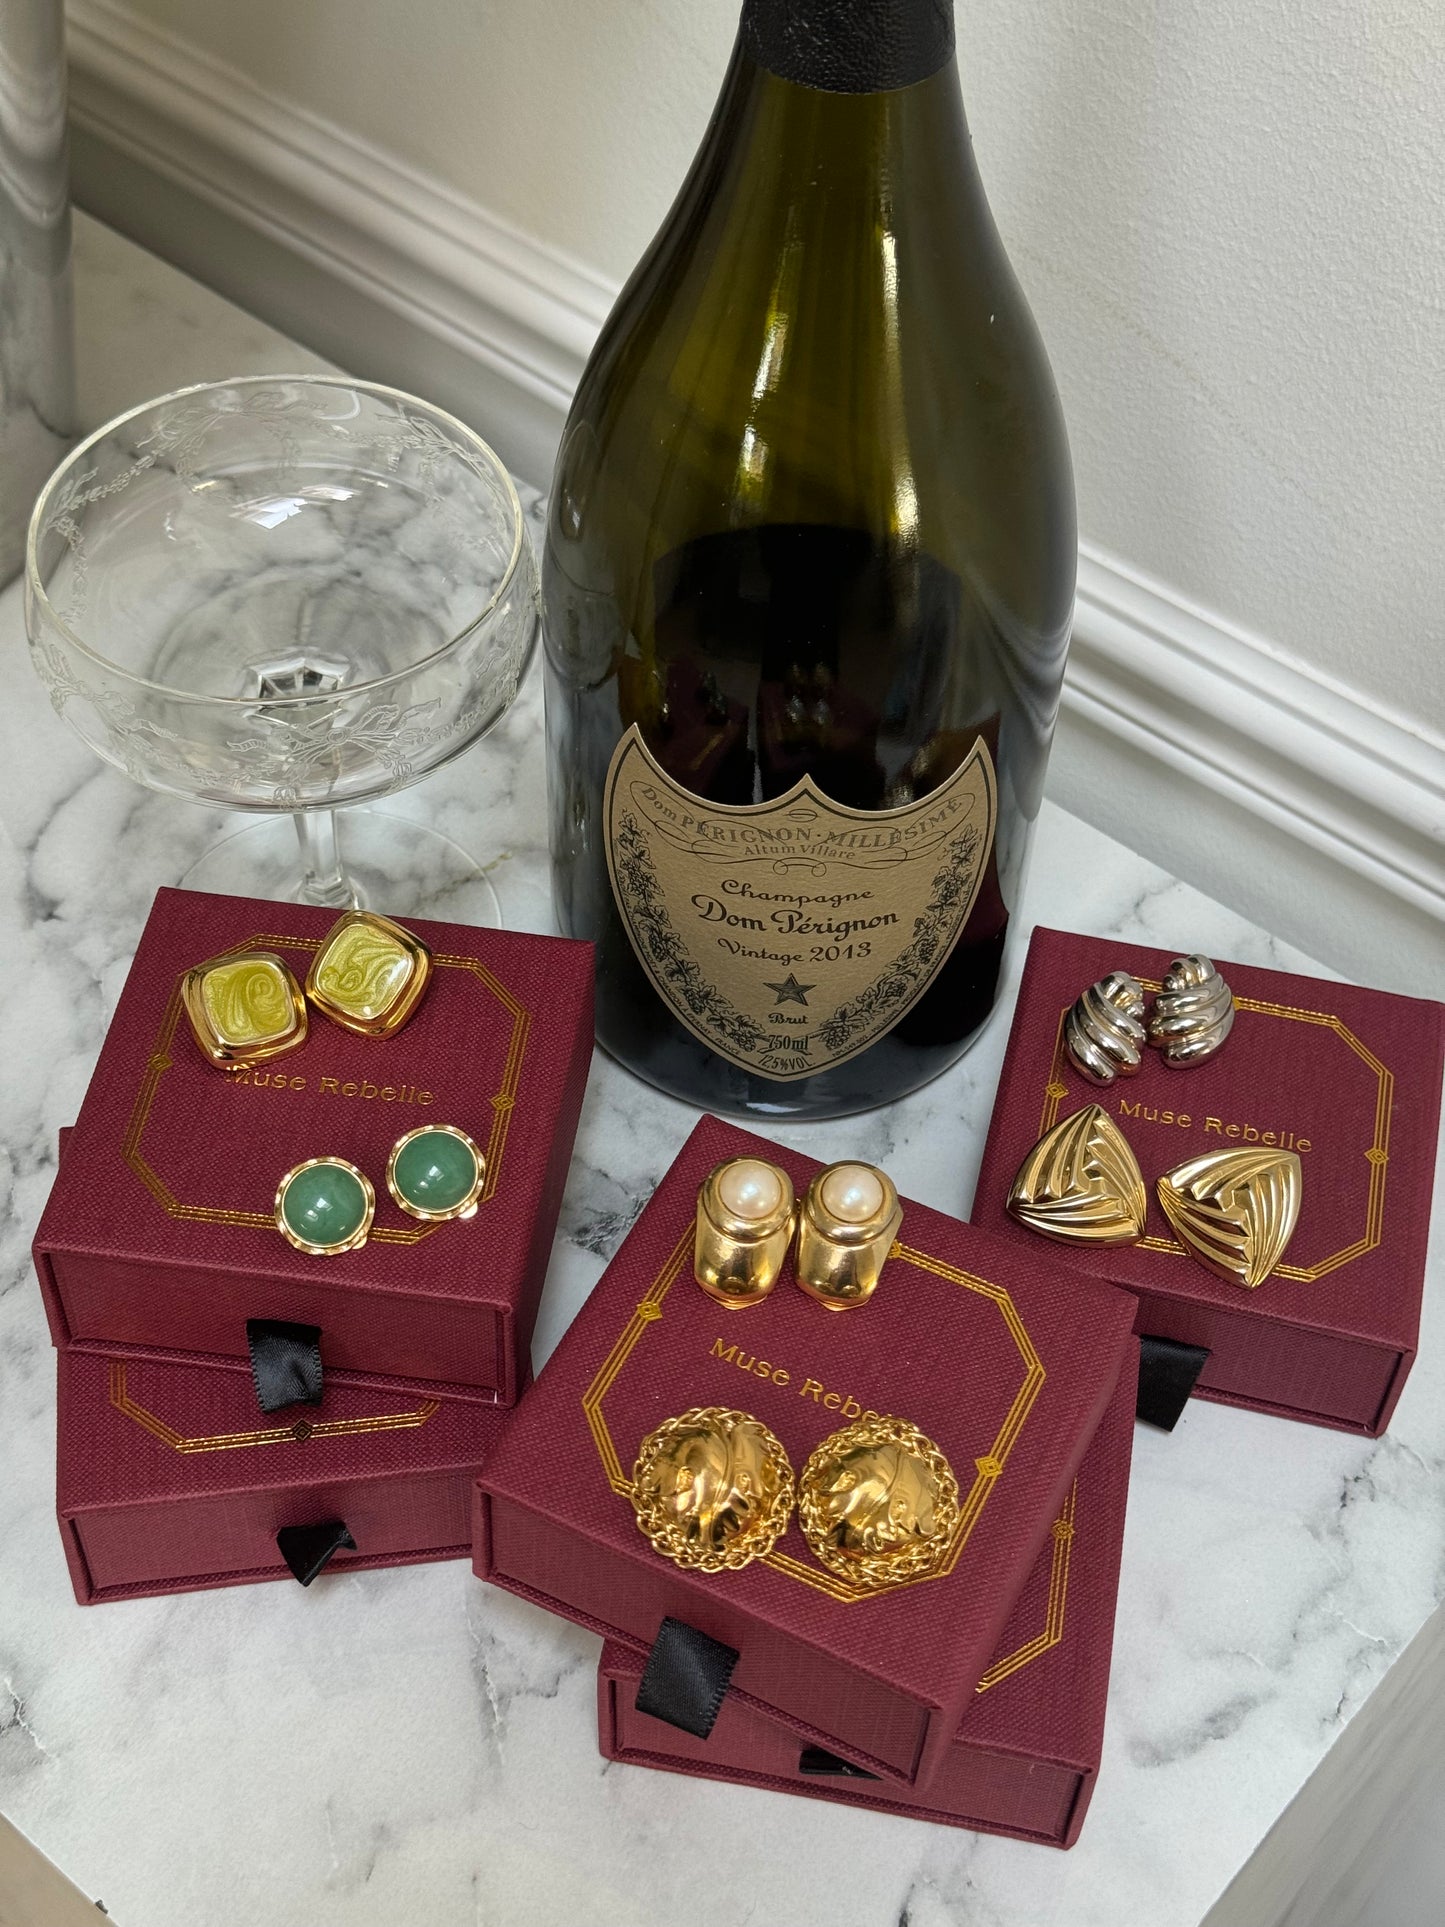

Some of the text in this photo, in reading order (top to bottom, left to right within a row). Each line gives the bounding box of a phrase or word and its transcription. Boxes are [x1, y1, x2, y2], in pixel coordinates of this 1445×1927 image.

[641, 786, 678, 821] Dom
[744, 844, 856, 860] Altum Villare
[720, 879, 875, 909] Champagne
[691, 894, 900, 942] Dom Pérignon
[717, 937, 872, 967] Vintage 2013
[768, 1012, 809, 1025] Brut
[768, 1034, 809, 1051] 750ml
[318, 1077, 435, 1105] Rebelle
[1118, 1099, 1313, 1152] Muse Rebelle
[708, 1337, 892, 1422] Muse Rebe
